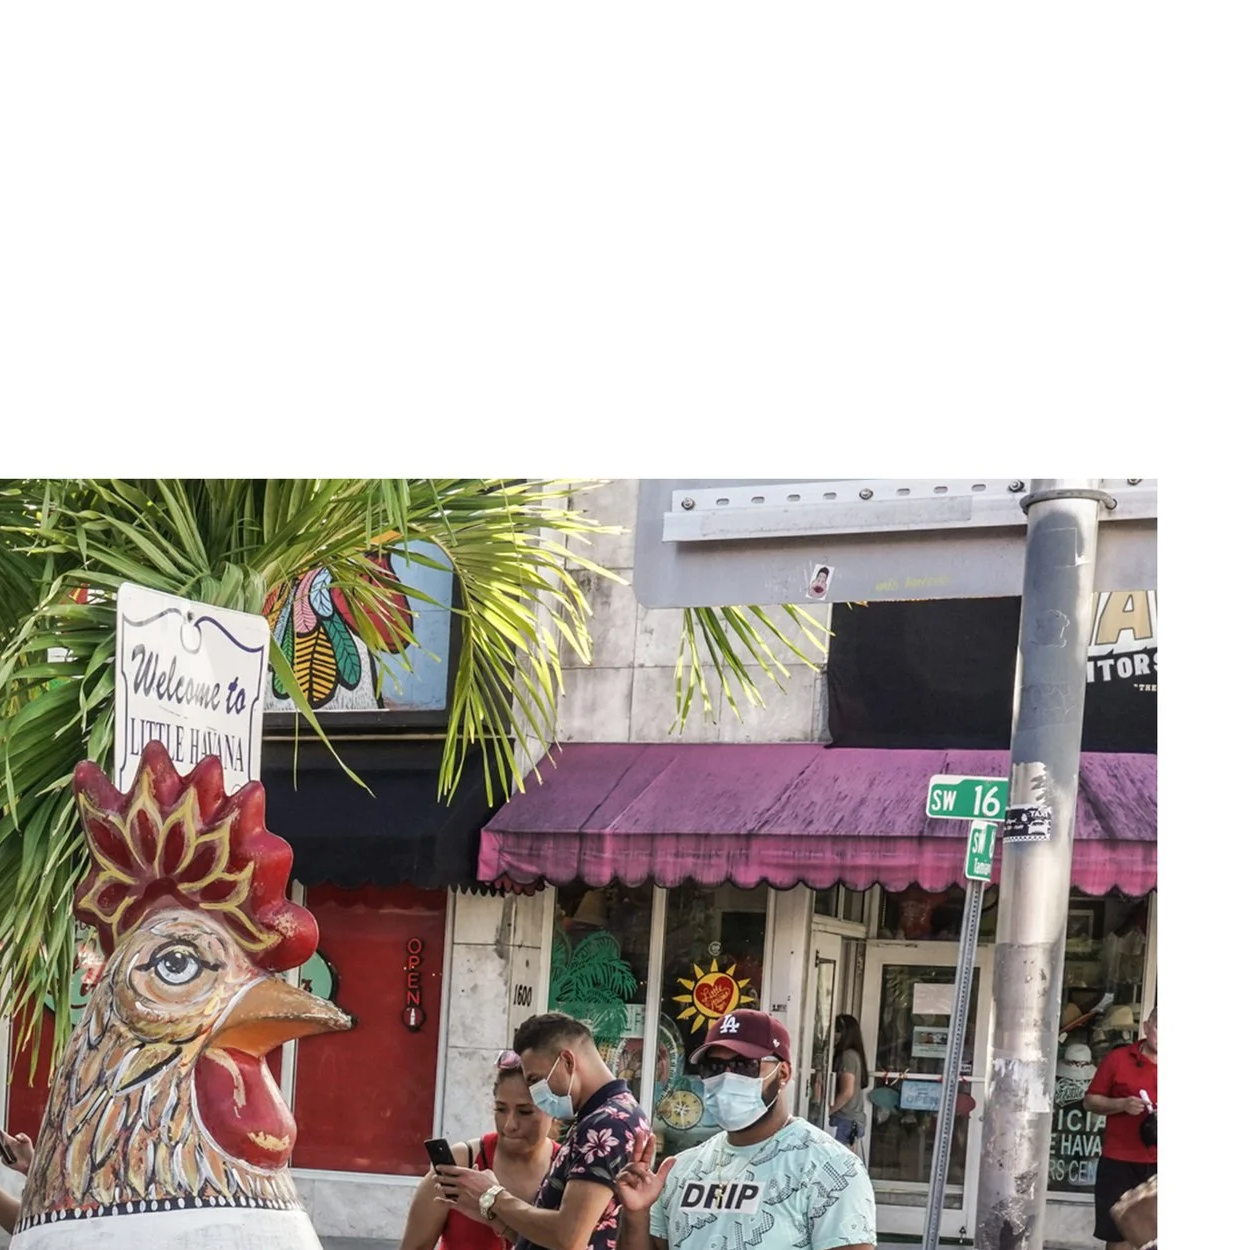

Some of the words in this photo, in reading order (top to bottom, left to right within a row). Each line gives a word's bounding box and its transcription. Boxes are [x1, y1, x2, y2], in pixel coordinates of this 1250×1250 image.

[131, 643, 220, 711] Welcome
[226, 676, 246, 715] to
[130, 717, 185, 763] LITTLE
[190, 727, 245, 773] HAVANA
[931, 789, 957, 812] SW
[973, 785, 1001, 817] 16
[972, 831, 987, 855] SW
[407, 938, 422, 1005] OPEN
[513, 983, 532, 1008] 1600
[720, 1014, 740, 1034] LA
[680, 1182, 760, 1210] DRIP
